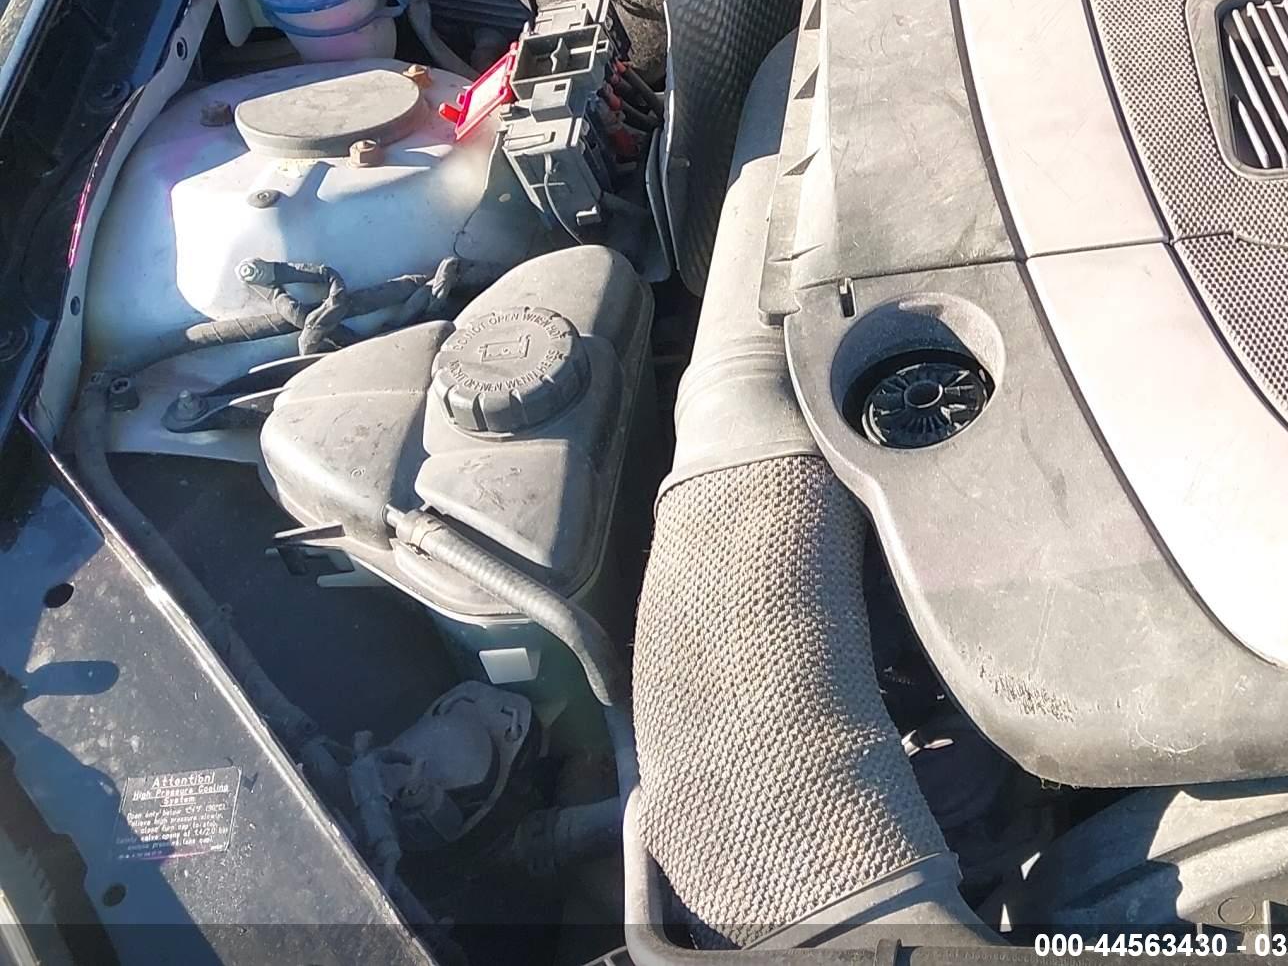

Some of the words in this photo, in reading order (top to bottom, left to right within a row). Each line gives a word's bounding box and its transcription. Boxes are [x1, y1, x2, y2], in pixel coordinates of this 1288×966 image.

[488, 314, 519, 326] OPEN
[132, 789, 152, 801] High
[156, 787, 194, 799] Pressure
[198, 783, 229, 795] Cooling
[163, 796, 196, 806] System
